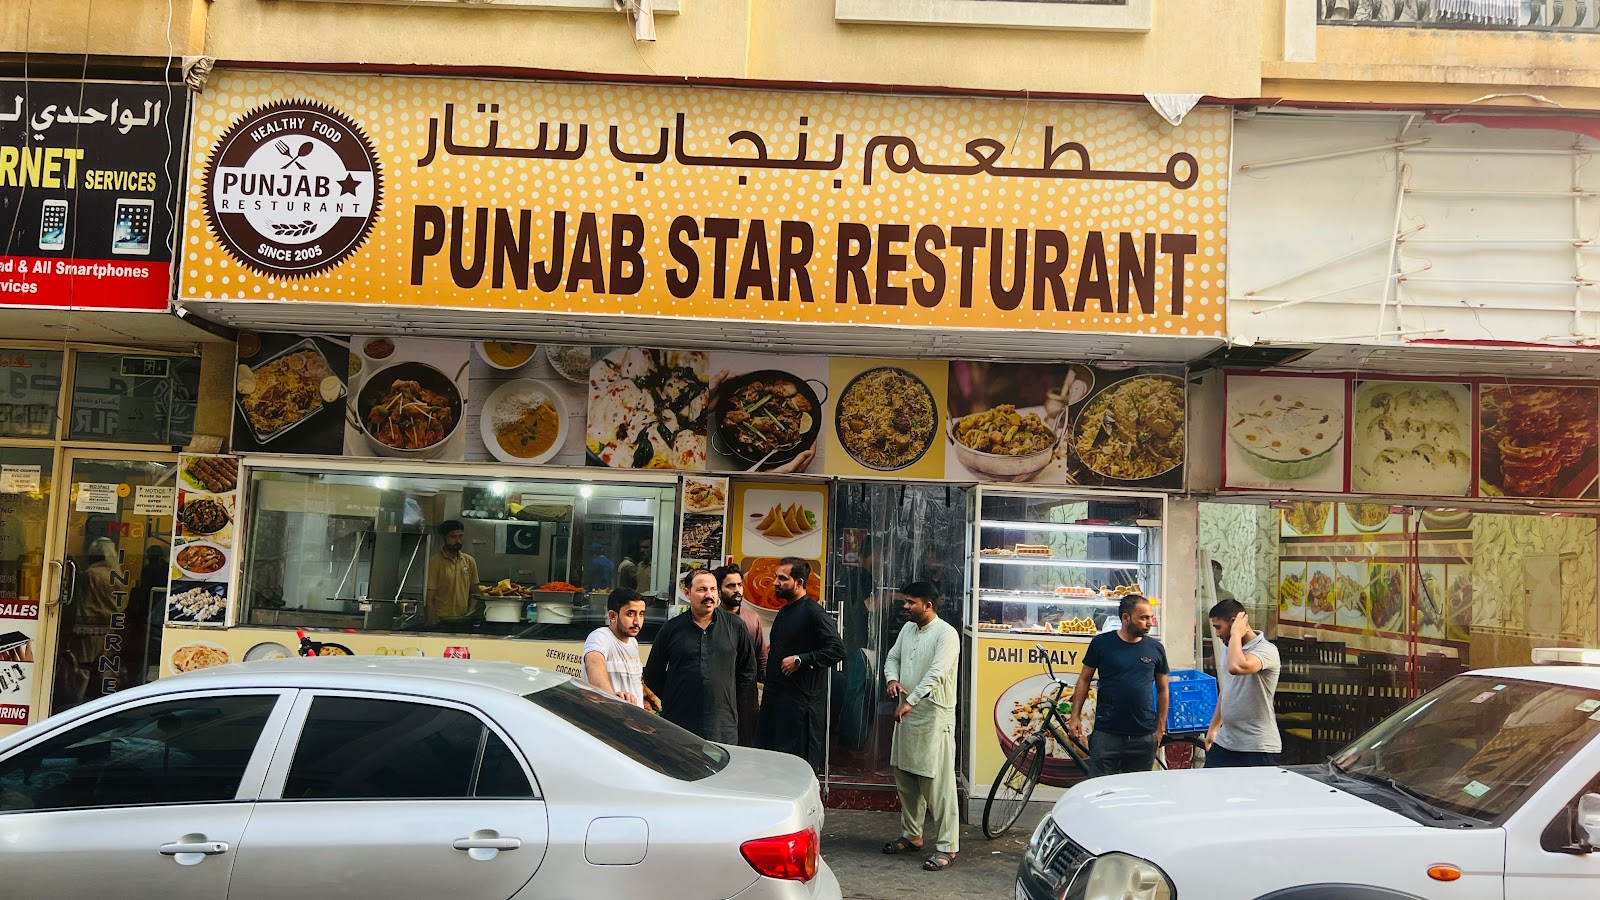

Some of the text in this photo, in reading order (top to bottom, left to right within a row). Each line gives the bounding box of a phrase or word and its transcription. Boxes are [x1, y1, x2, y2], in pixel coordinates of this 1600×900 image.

[250, 118, 343, 144] HEALTHY FOOD
[417, 102, 1199, 190] مطعم بنجاب ستار
[85, 170, 157, 192] SERVICES
[222, 172, 331, 198] PUNJAB
[222, 199, 361, 214] RESTURANT
[257, 242, 323, 262] SINCE 2005
[410, 204, 1197, 316] PUNJAB STAR RESTURANT
[18, 259, 28, 273] &
[32, 260, 52, 274] All
[56, 261, 149, 279] Smartphones
[0, 278, 38, 294] vices
[546, 649, 566, 661] SEEKH
[987, 646, 1023, 663] DAHI
